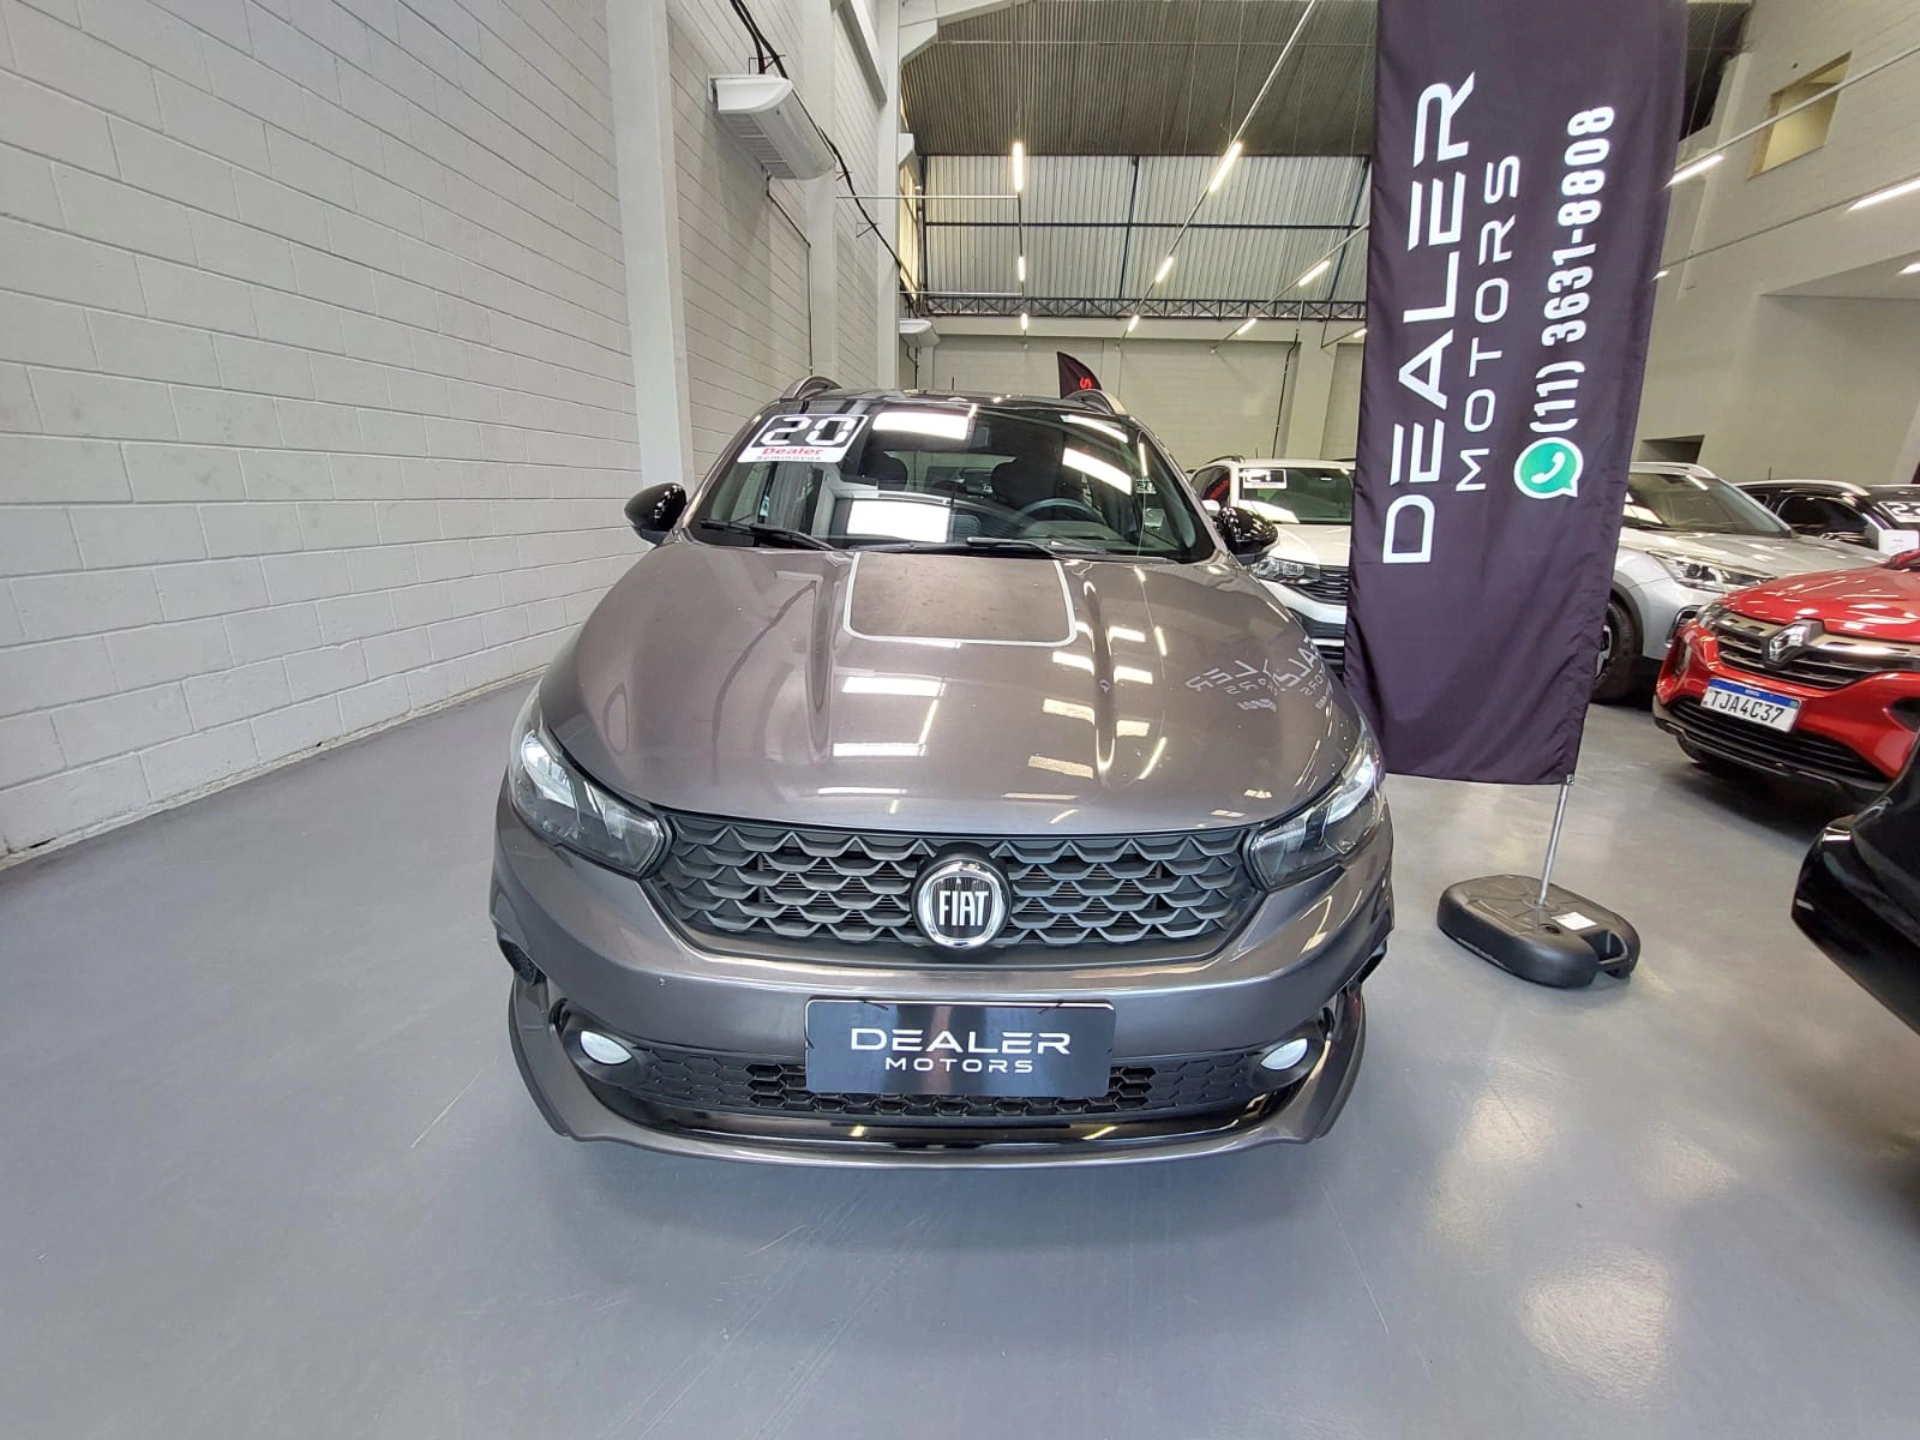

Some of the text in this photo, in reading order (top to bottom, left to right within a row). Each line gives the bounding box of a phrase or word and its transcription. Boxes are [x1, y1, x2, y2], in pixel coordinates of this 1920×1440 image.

[1529, 105, 1615, 433] (11) 3631-8808
[1382, 71, 1475, 564] DEALER
[1455, 154, 1521, 492] MOTORS
[760, 417, 857, 446] 20
[762, 447, 824, 455] Dealer
[1710, 690, 1785, 724] TJA4C37
[938, 890, 989, 926] FIAT
[850, 1028, 1071, 1055] DEALER
[885, 1057, 1034, 1074] MOTORS
